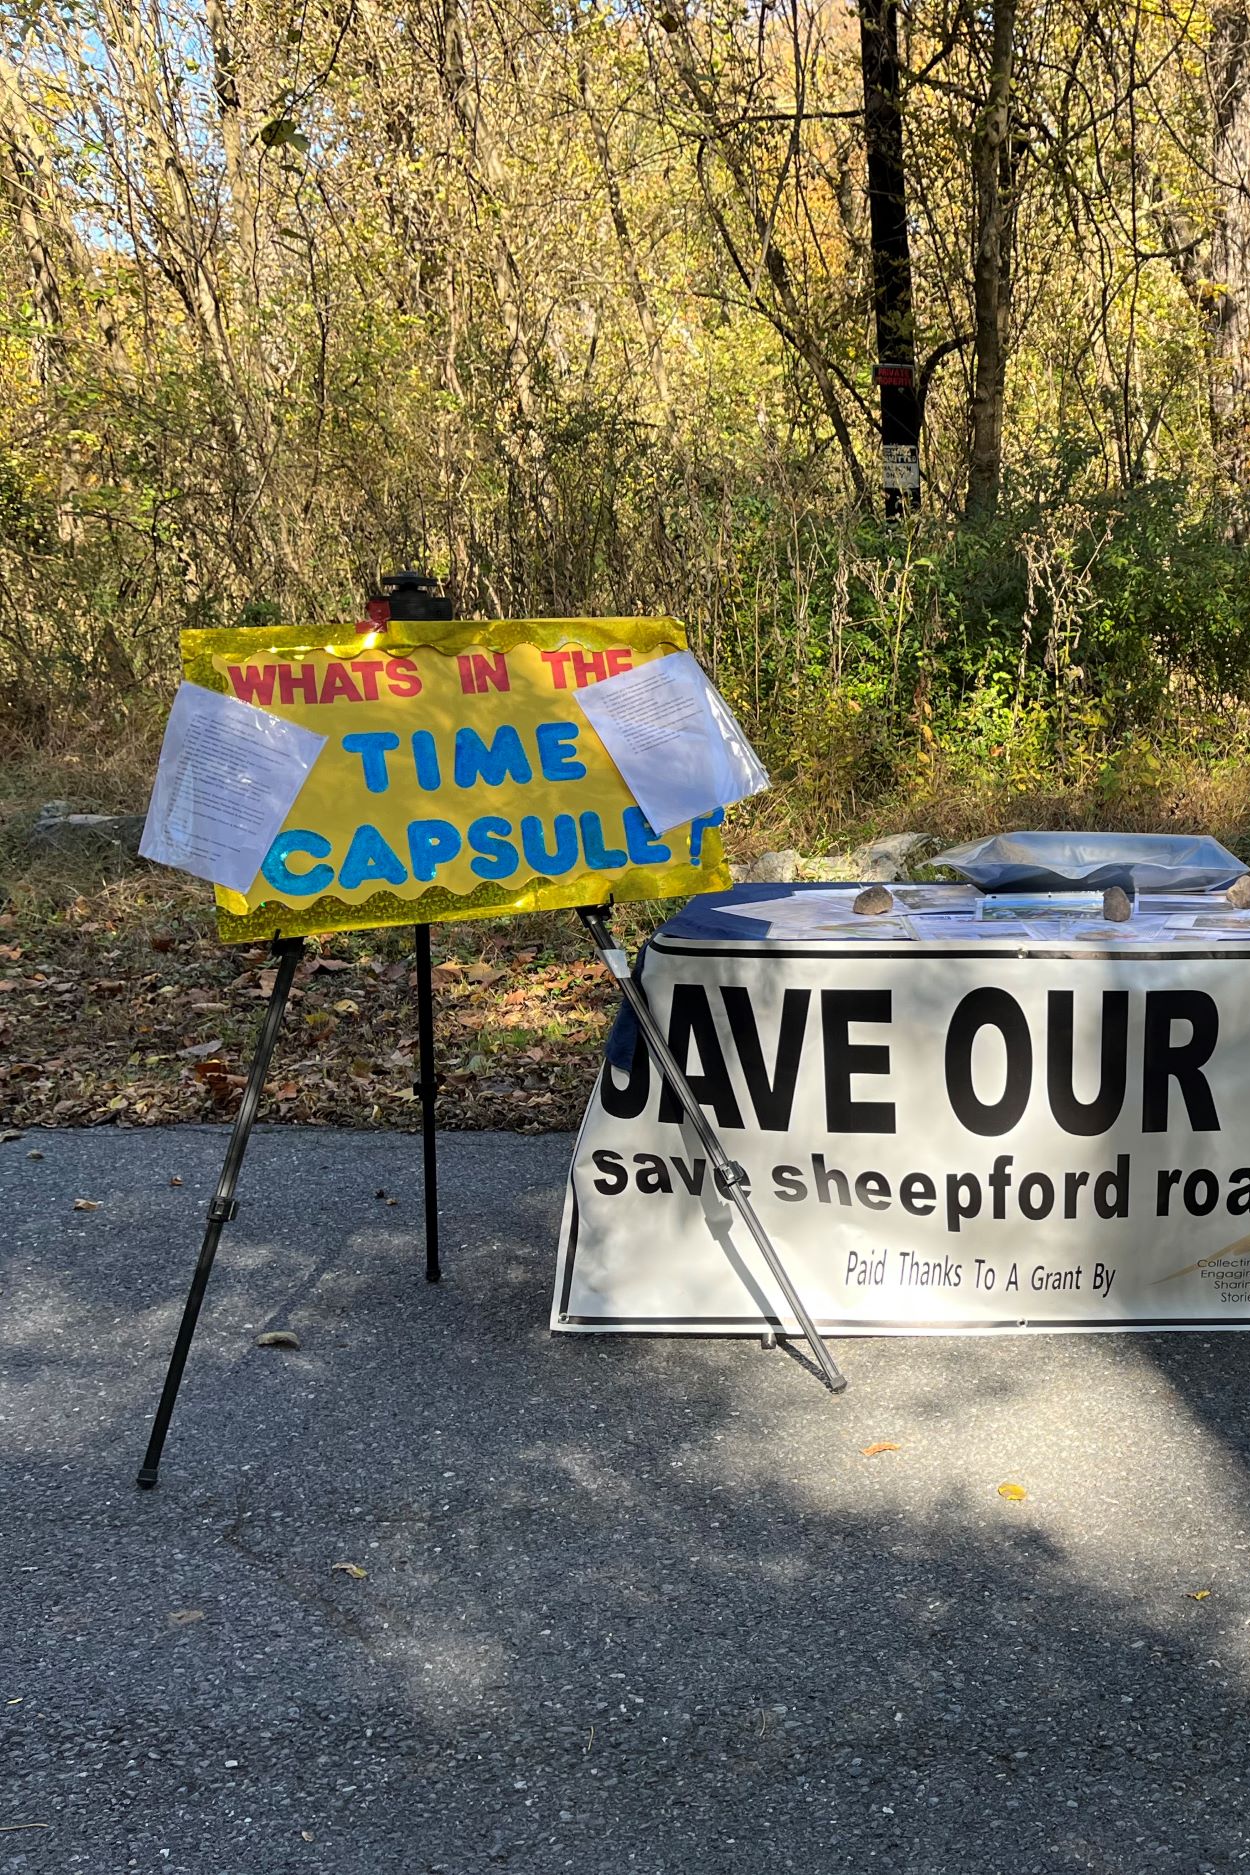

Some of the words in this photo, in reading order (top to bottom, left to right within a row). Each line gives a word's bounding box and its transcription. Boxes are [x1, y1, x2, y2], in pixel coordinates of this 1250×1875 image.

[227, 658, 423, 706] WHATS
[457, 652, 510, 695] IN
[541, 649, 633, 691] THE
[342, 722, 588, 794] TIME
[945, 986, 1221, 1137] OUR
[773, 1153, 1131, 1232] sheepford
[845, 1249, 888, 1287] Paid
[898, 1250, 962, 1288] Thanks
[974, 1259, 997, 1291] To
[1005, 1263, 1019, 1292] A
[1031, 1263, 1081, 1291] Grant
[1092, 1262, 1116, 1298] By
